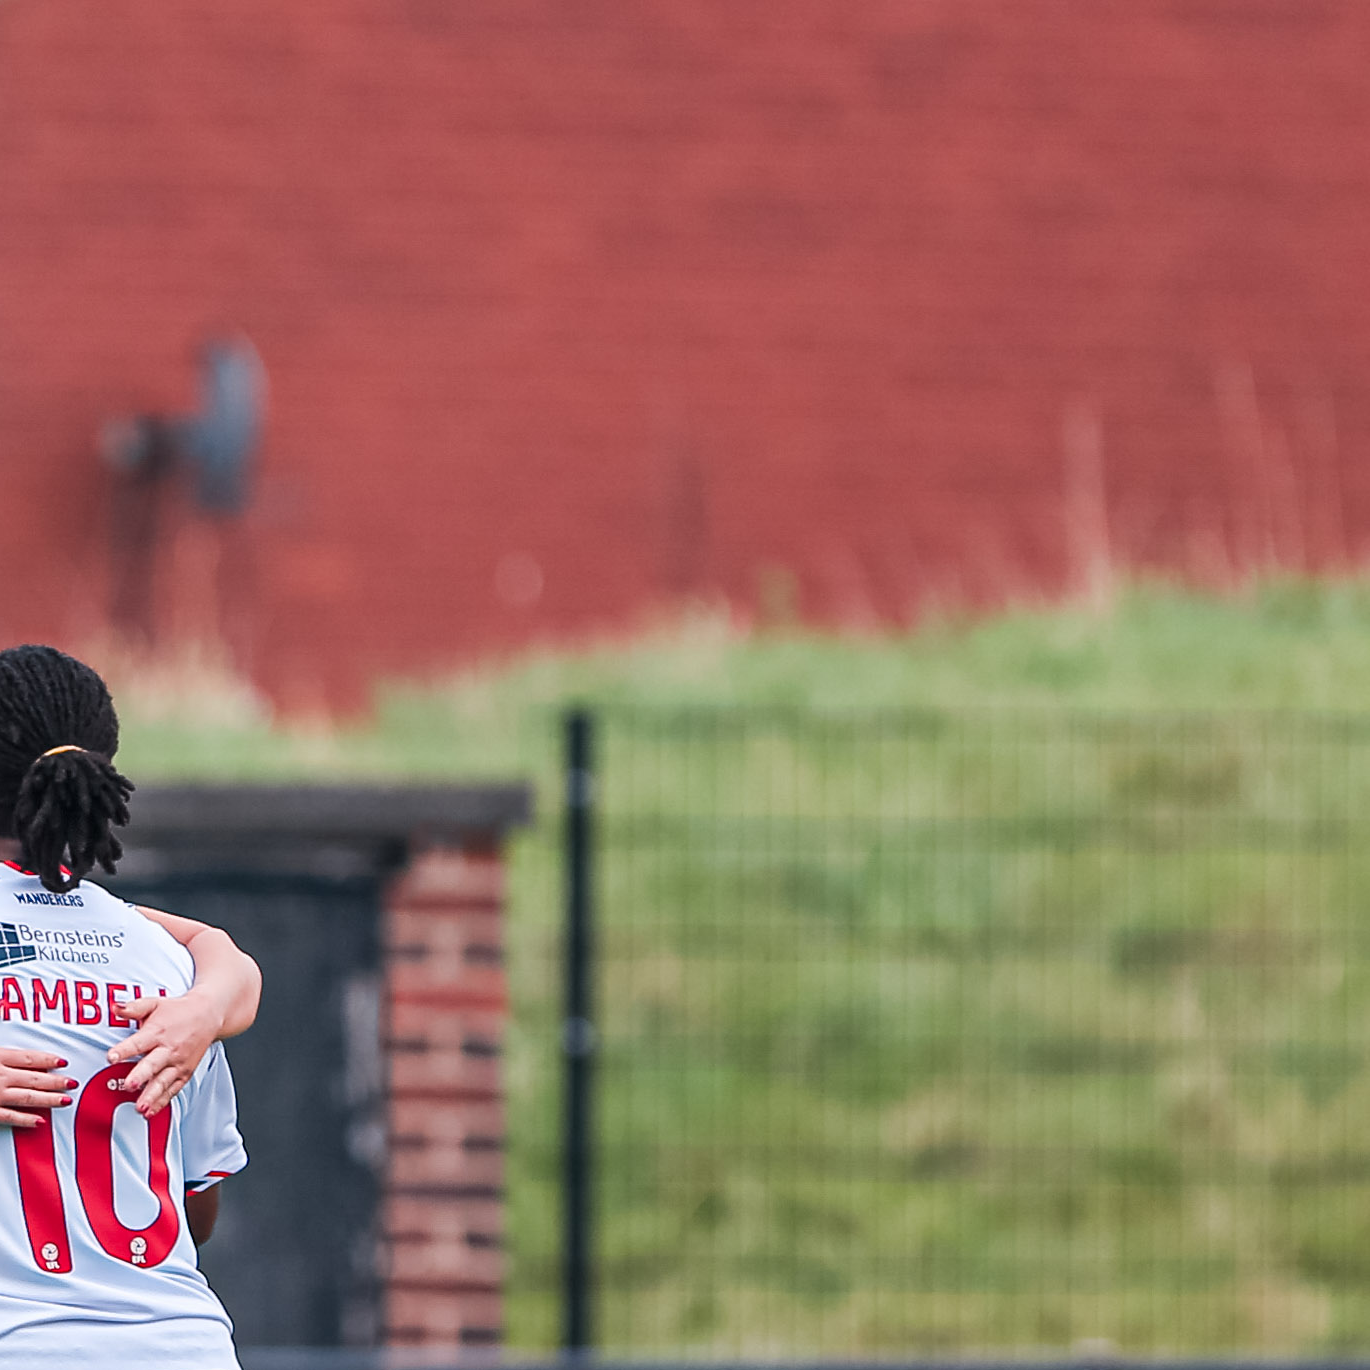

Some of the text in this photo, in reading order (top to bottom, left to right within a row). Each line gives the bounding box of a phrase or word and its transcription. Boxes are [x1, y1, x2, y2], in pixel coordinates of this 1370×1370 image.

[13, 892, 85, 908] WANDERERS
[37, 945, 110, 965] Kitchens
[12, 1061, 180, 1274] 10
